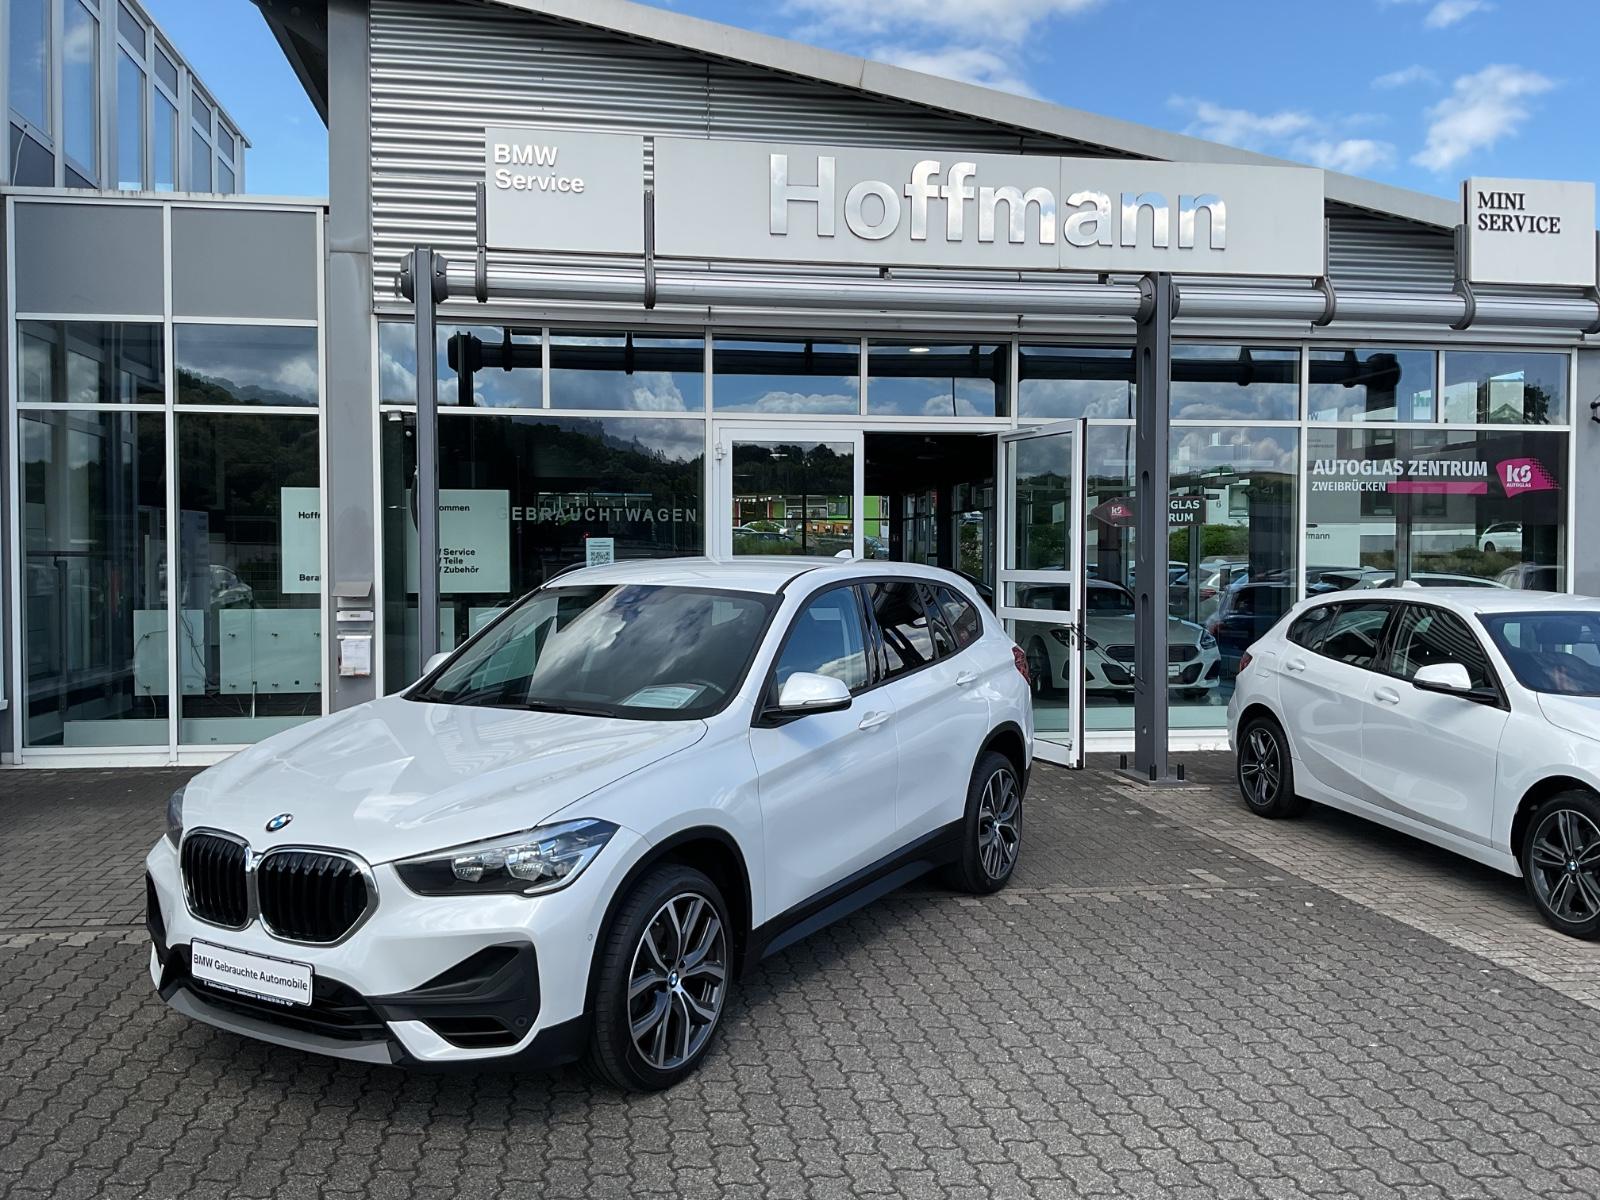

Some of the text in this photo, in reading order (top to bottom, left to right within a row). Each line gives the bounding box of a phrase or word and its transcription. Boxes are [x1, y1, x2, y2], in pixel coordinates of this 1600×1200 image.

[494, 143, 558, 167] BMW
[495, 168, 585, 193] Service
[769, 153, 1227, 250] Hoffmann
[1477, 191, 1526, 211] MINI
[1478, 213, 1561, 234] SERVICE
[1312, 459, 1488, 477] AUTOGLAS ZENTRUM
[1311, 479, 1386, 492] ZWEIBRÜCKEN
[1169, 500, 1200, 509] GLAS
[1168, 513, 1194, 522] RUM
[443, 548, 476, 556] Service
[443, 557, 464, 565] Teile
[299, 573, 321, 581] Bera
[443, 566, 480, 574] Zubehör
[193, 953, 308, 990] BMW Gebrauchte Automobile
